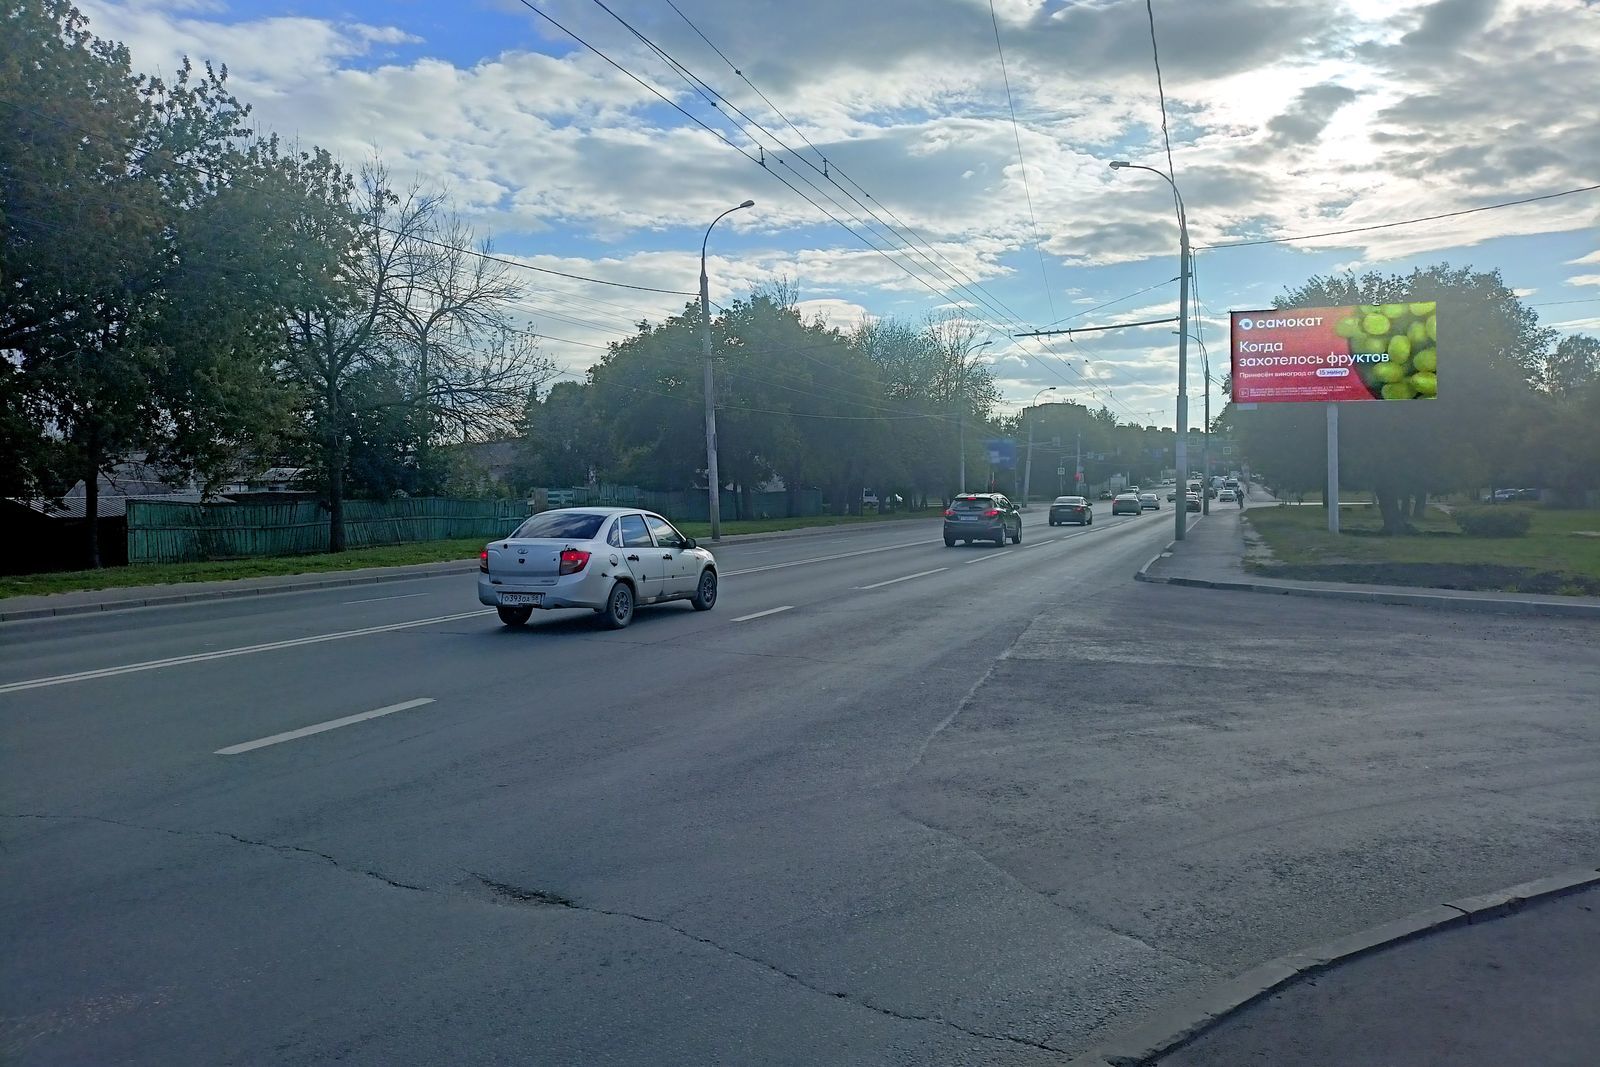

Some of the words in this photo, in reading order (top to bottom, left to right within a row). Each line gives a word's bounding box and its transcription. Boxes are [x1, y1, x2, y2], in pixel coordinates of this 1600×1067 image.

[1256, 317, 1323, 328] самокат
[1239, 341, 1283, 353] Когда
[1239, 355, 1324, 367] захотелось
[1326, 352, 1390, 367] фруктов
[1239, 371, 1274, 379] Принесём
